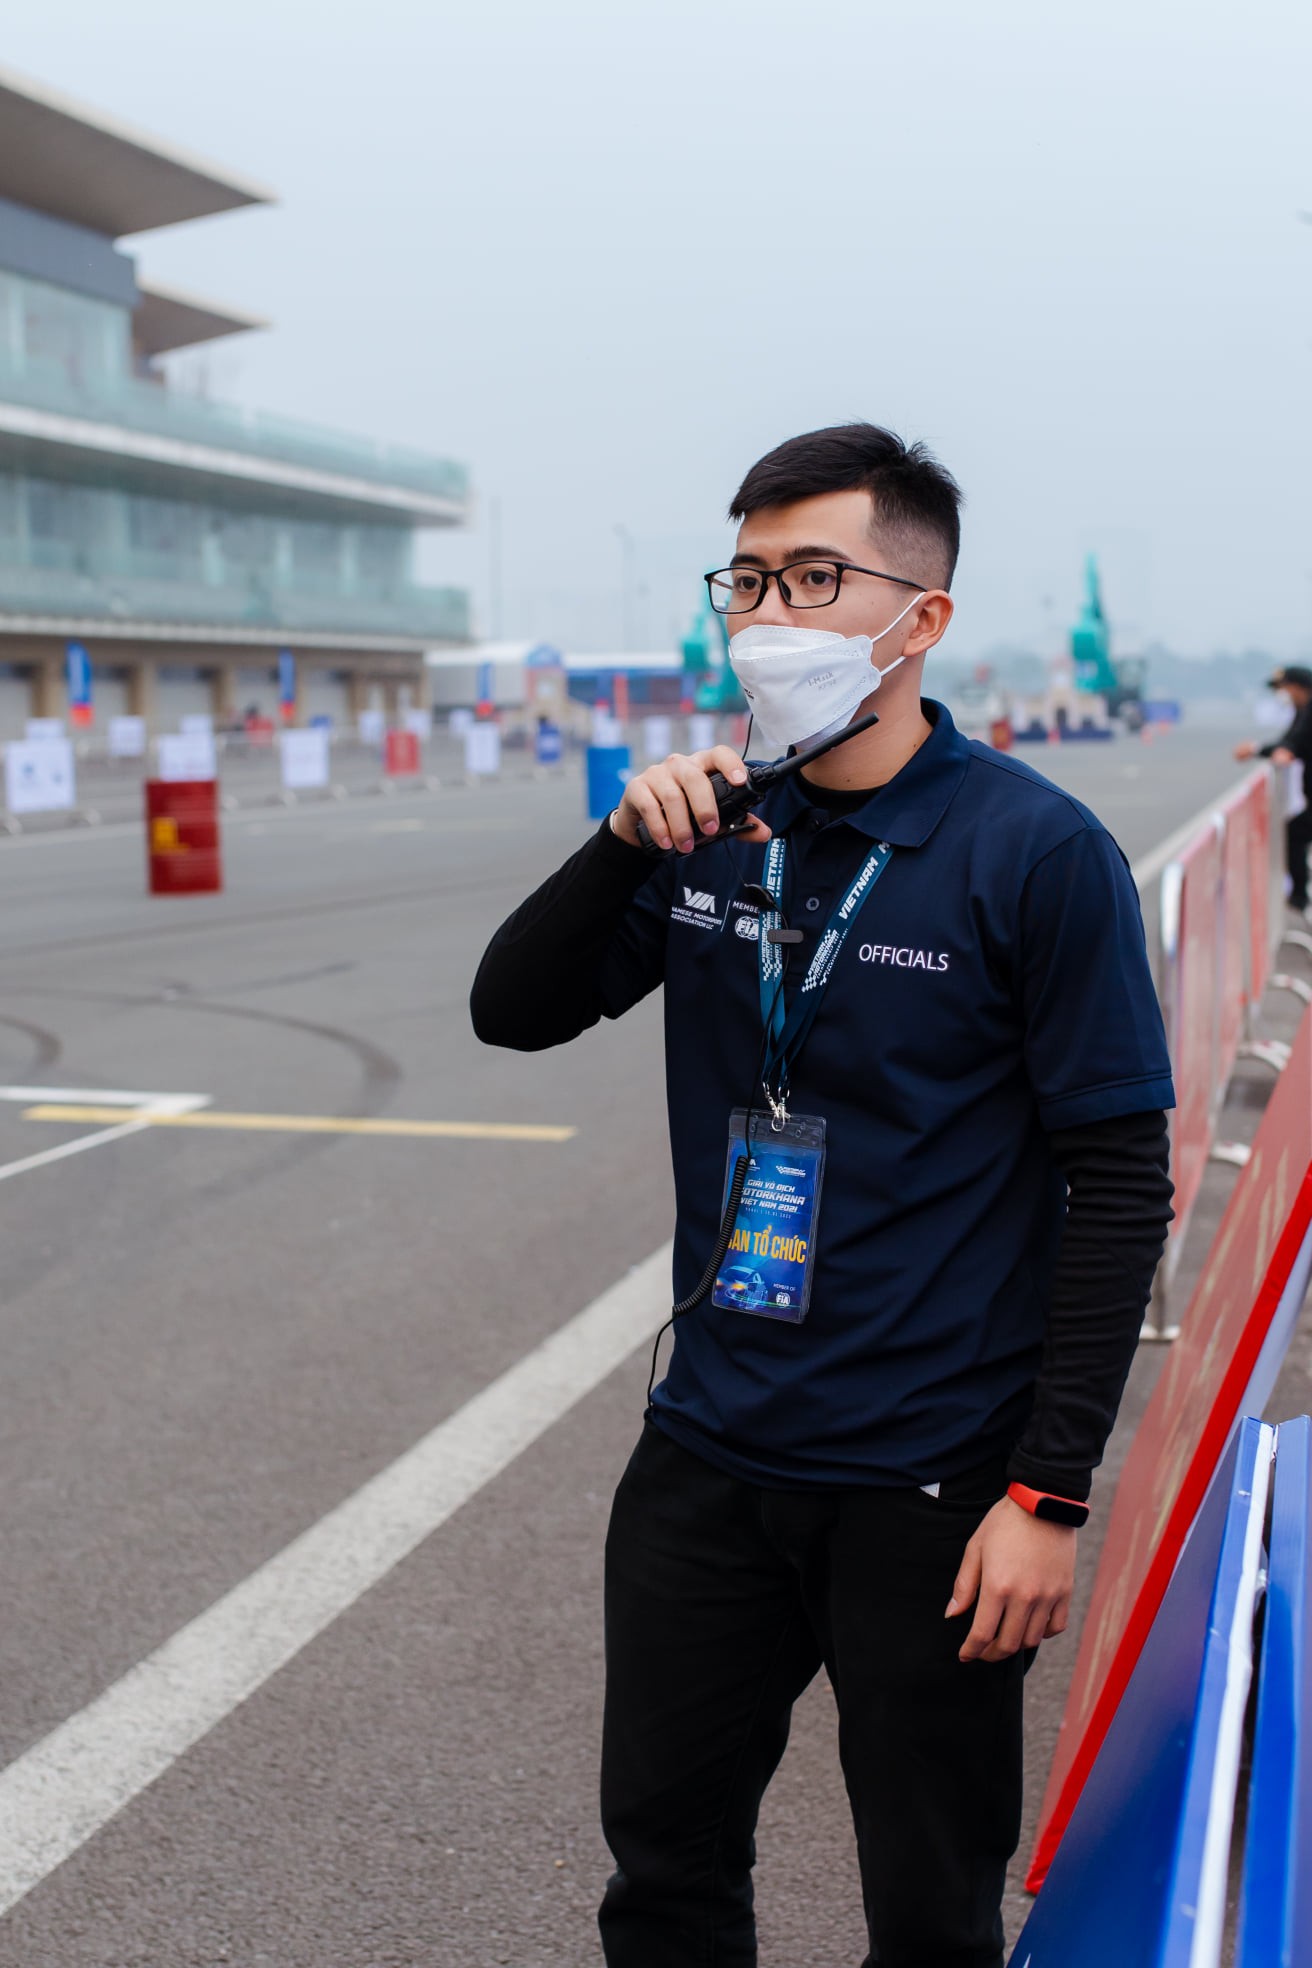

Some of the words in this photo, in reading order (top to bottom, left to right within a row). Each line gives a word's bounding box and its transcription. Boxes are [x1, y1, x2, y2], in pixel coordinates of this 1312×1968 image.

[838, 856, 879, 920] VIETNAM
[732, 901, 760, 914] MEMBE
[858, 943, 949, 972] OFFICIALS
[741, 1187, 806, 1206] OTORKHANA
[759, 1200, 777, 1210] NAM
[778, 1204, 798, 1214] 2021
[728, 1228, 751, 1253] AN
[753, 1225, 772, 1257] TỔ
[771, 1235, 807, 1264] CHỨC
